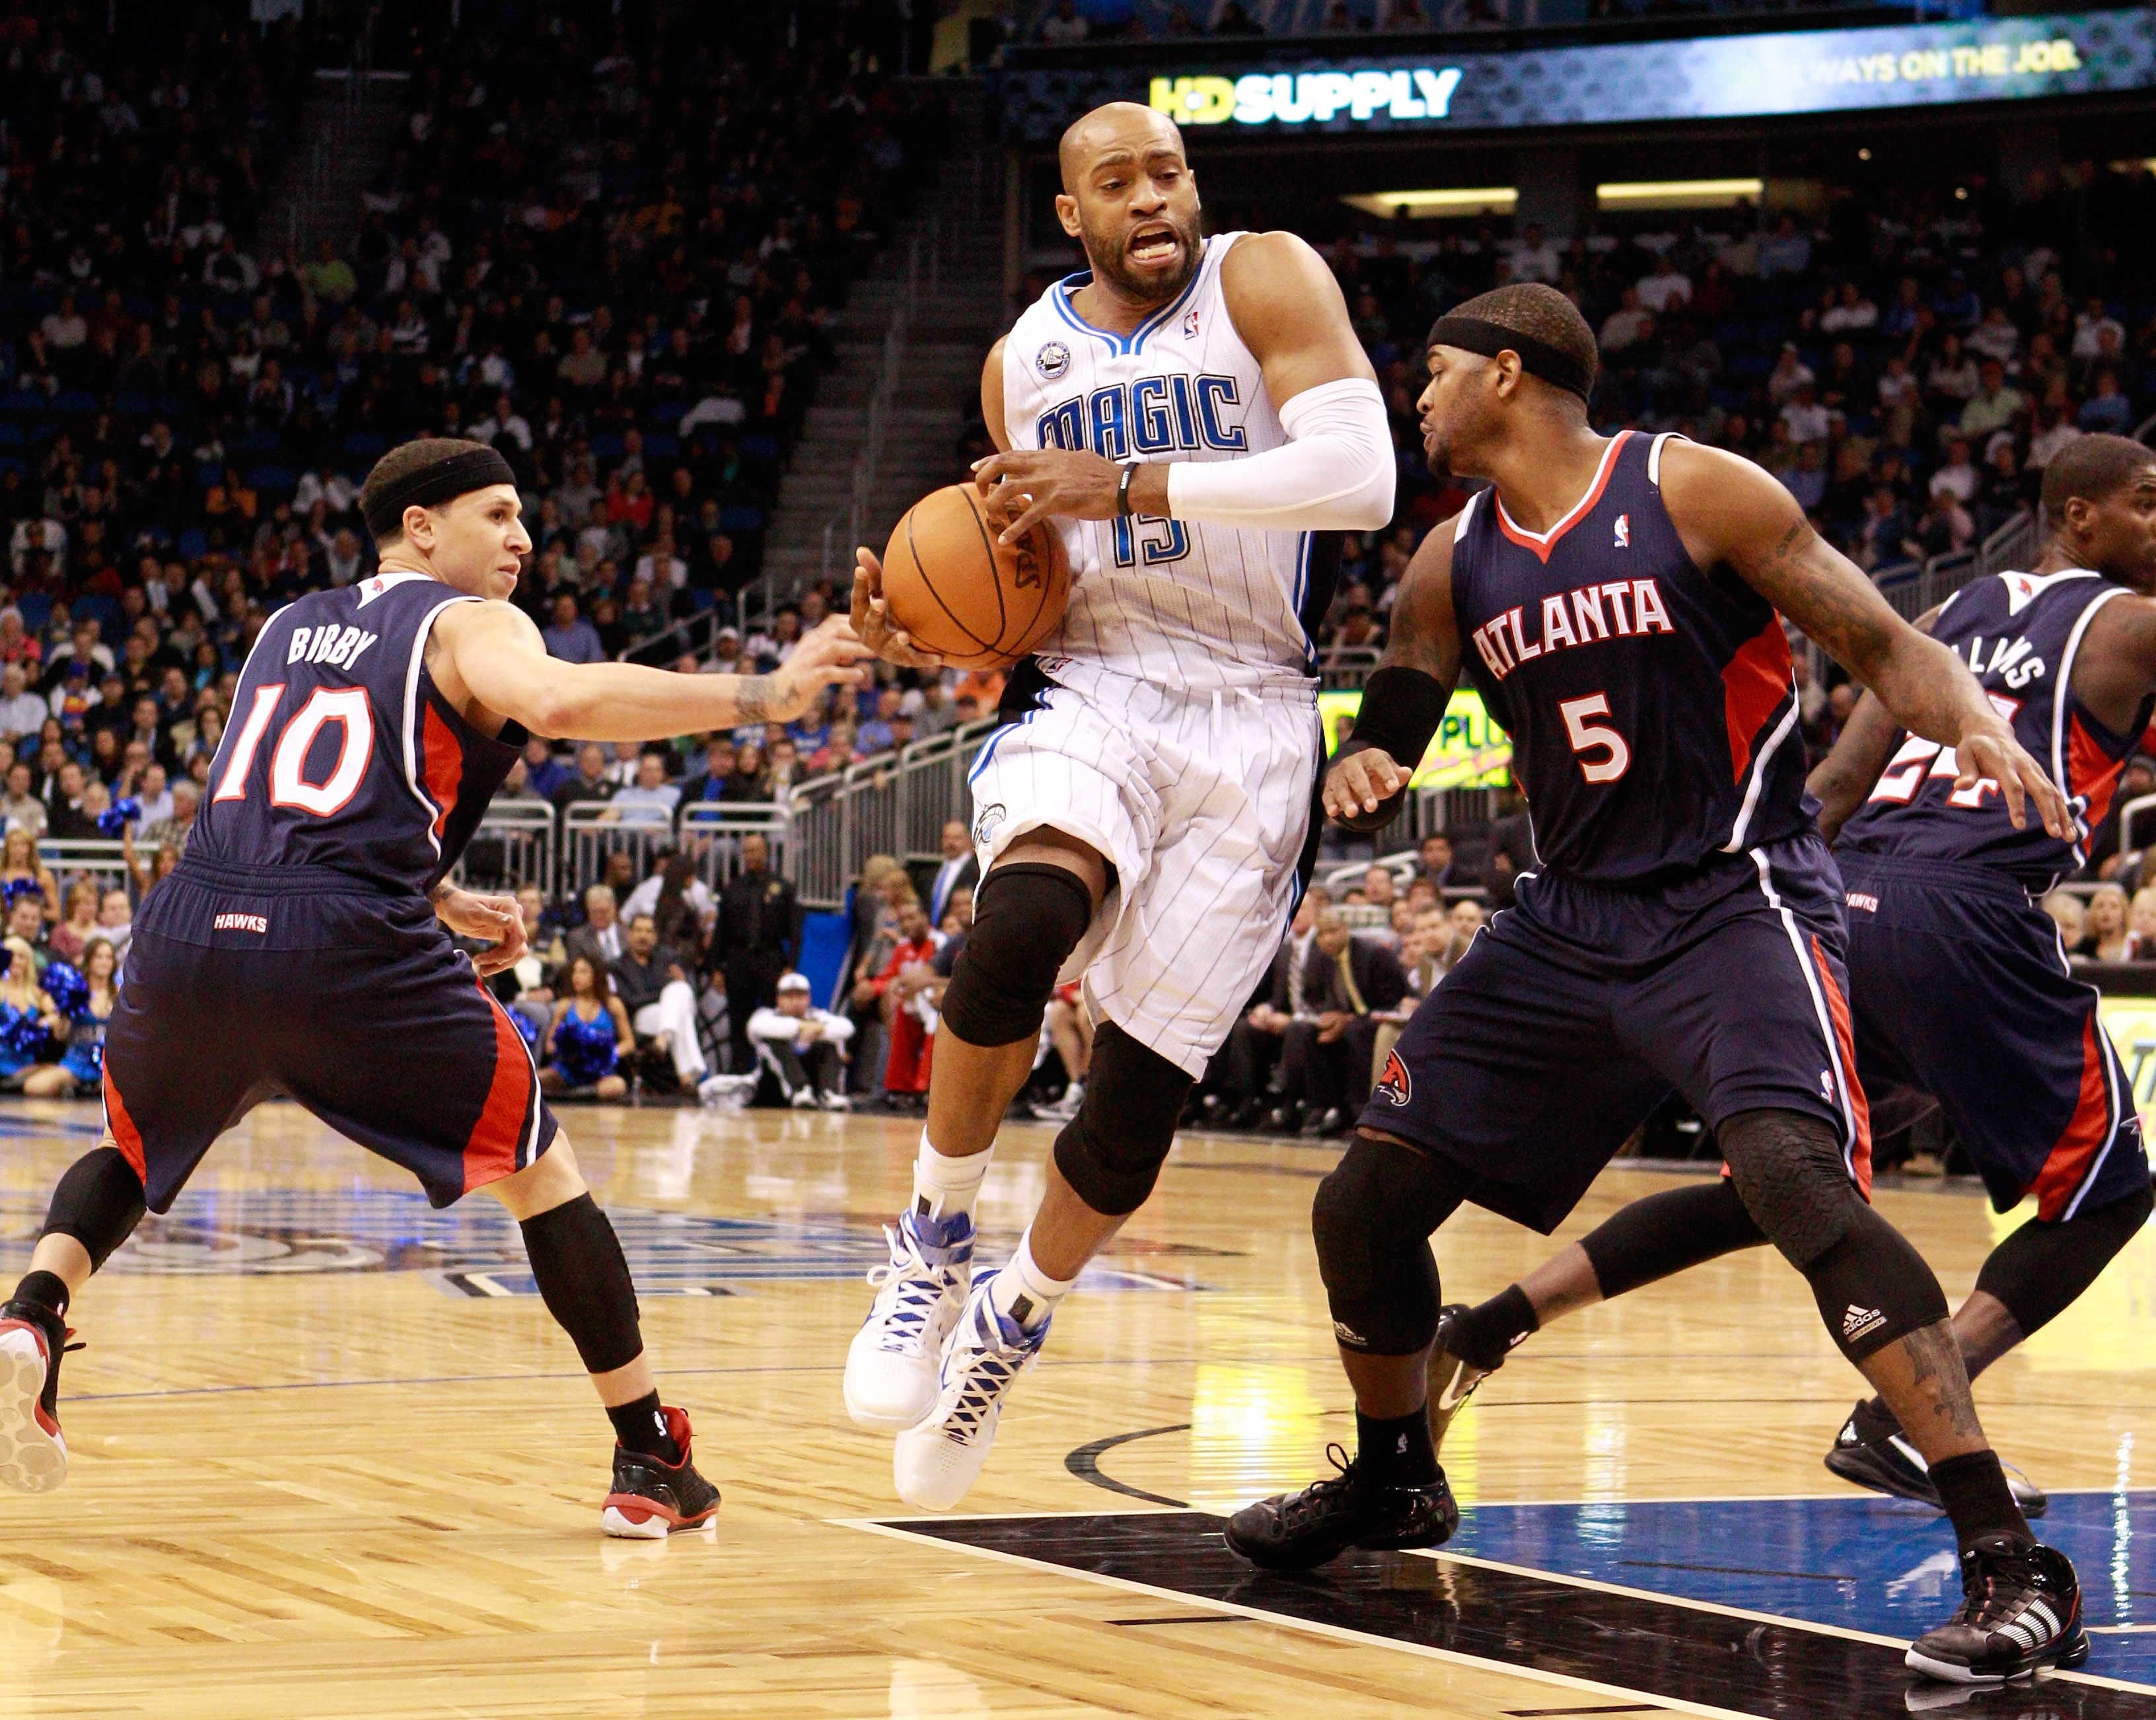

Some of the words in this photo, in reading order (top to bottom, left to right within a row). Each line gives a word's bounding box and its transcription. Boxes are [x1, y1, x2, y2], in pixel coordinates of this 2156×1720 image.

[1900, 49, 1949, 81] ON
[1952, 44, 2009, 77] THE
[1036, 373, 1249, 460] MAGIC
[287, 624, 378, 671] BIBBY
[1472, 577, 1676, 681] ATLANTA
[211, 683, 375, 818] 10
[1558, 691, 1631, 785] 5
[213, 912, 268, 934] HAWKS
[1844, 1308, 1881, 1335] adidas
